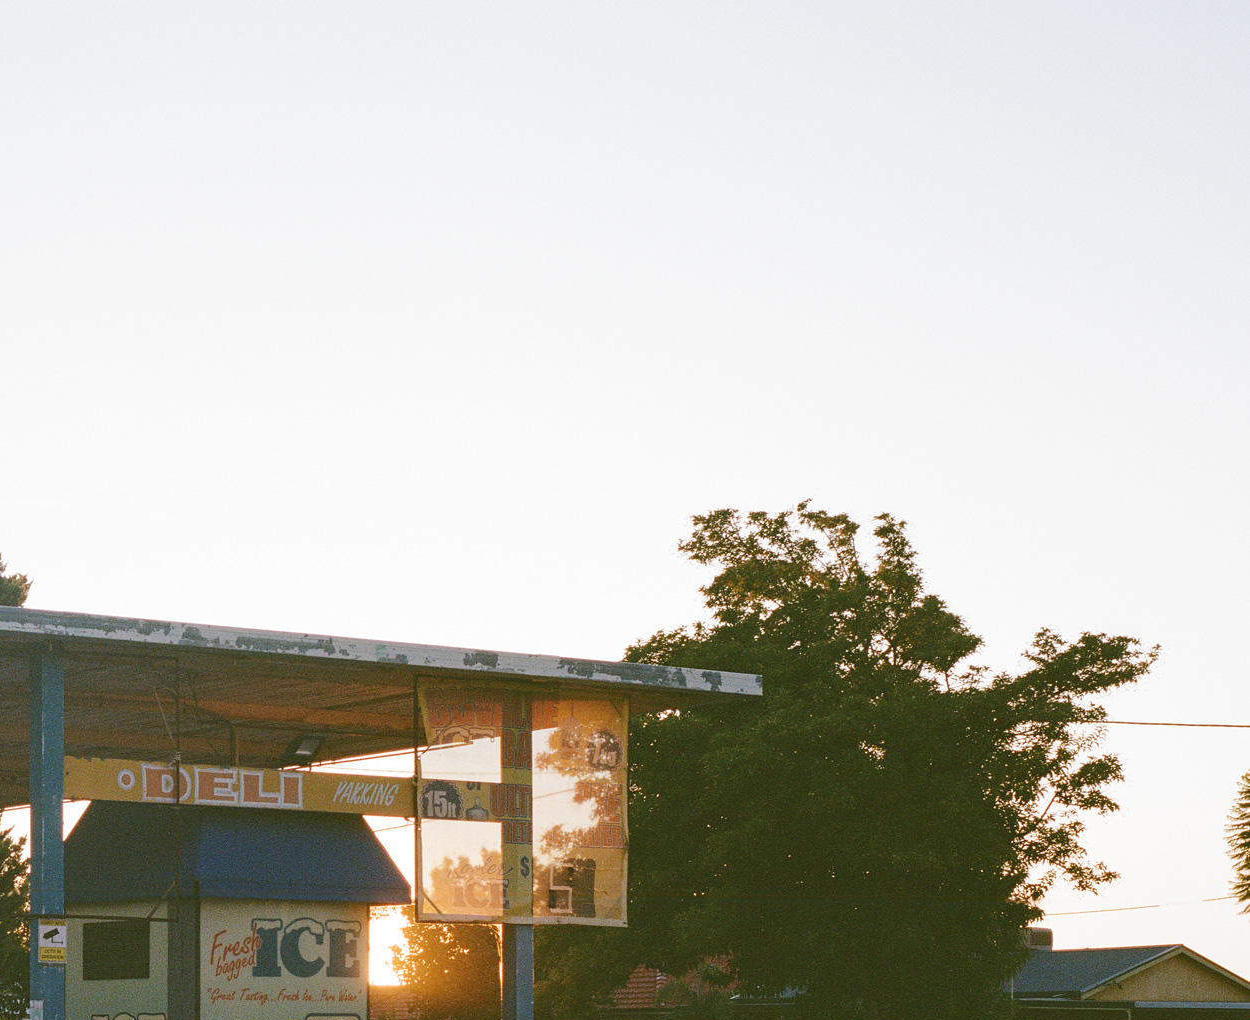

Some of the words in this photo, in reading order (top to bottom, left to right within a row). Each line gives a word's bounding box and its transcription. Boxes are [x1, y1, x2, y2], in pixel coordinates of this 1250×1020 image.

[141, 763, 303, 809] DELI
[452, 878, 510, 909] ICE
[210, 922, 262, 965] Fresh
[251, 917, 362, 978] ICE
[215, 953, 256, 982] bagged
